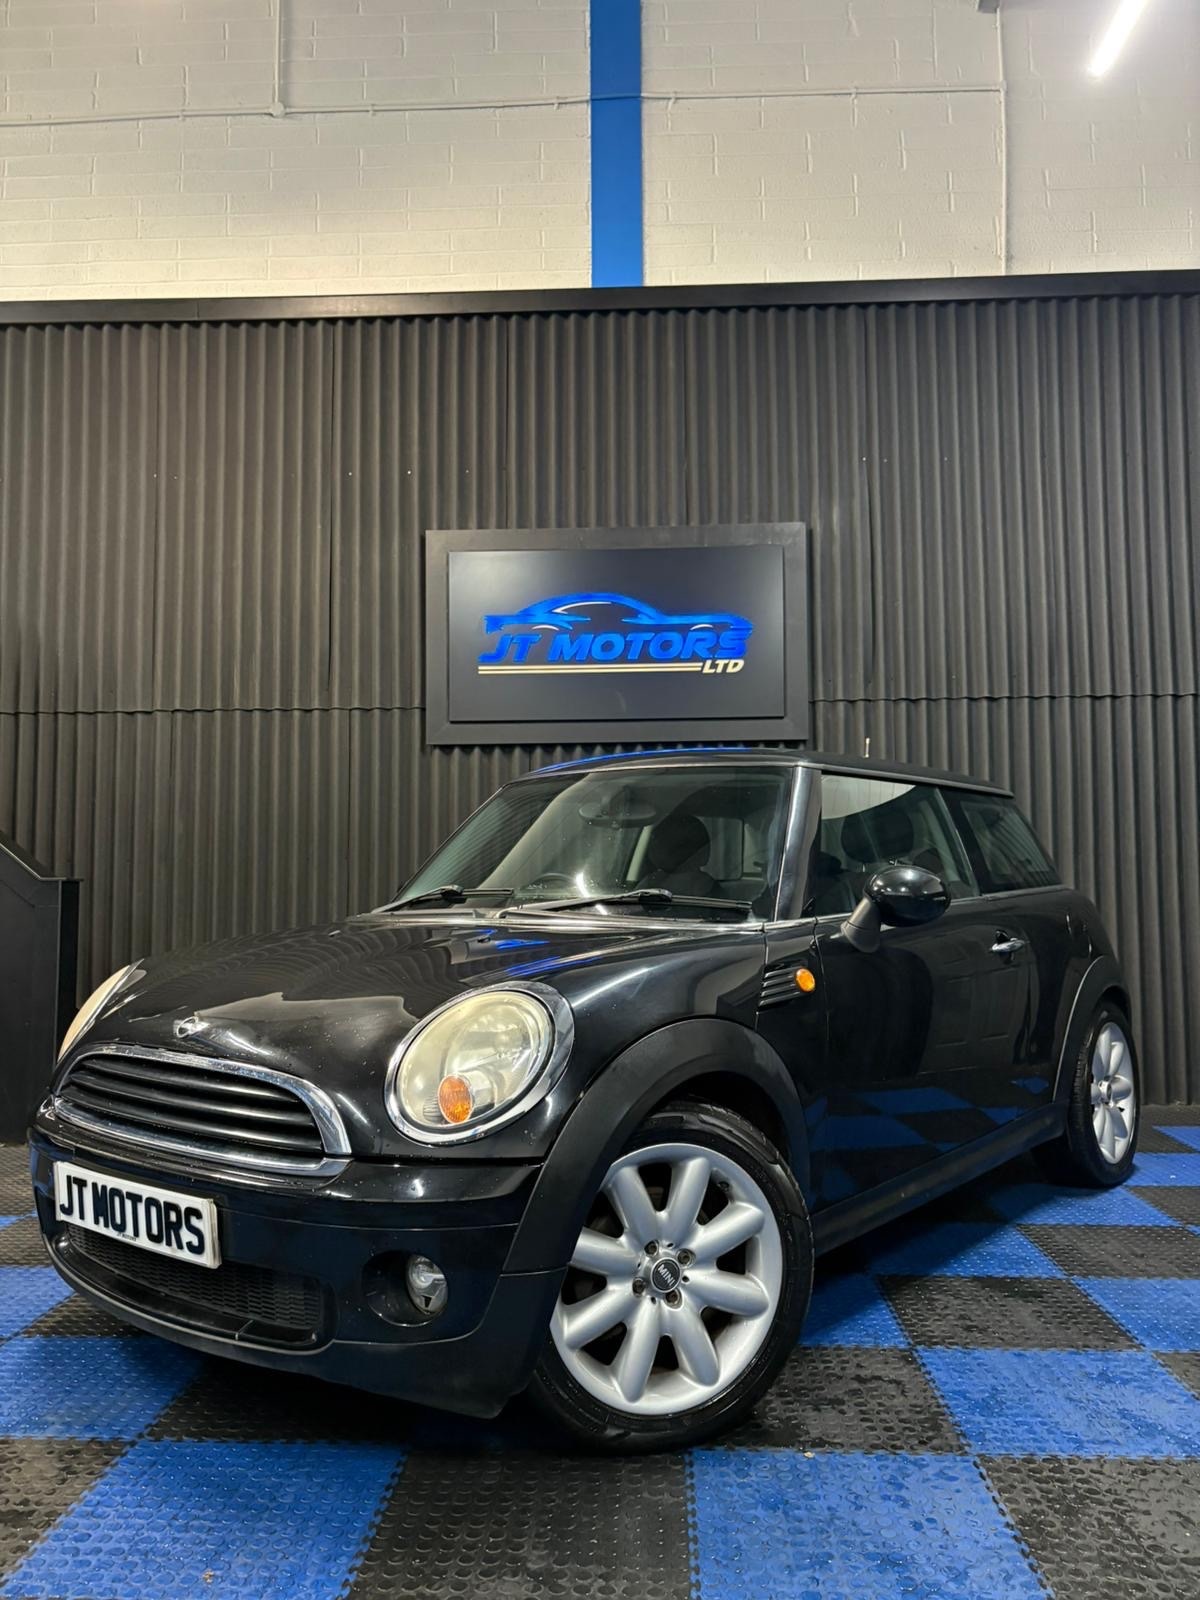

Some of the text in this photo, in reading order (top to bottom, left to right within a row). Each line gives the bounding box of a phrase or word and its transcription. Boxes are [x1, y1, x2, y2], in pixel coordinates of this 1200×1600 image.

[478, 631, 752, 663] JT MOTORS
[702, 659, 744, 674] LTD
[59, 1175, 205, 1256] JT MOTORS
[657, 1263, 676, 1286] MINI
